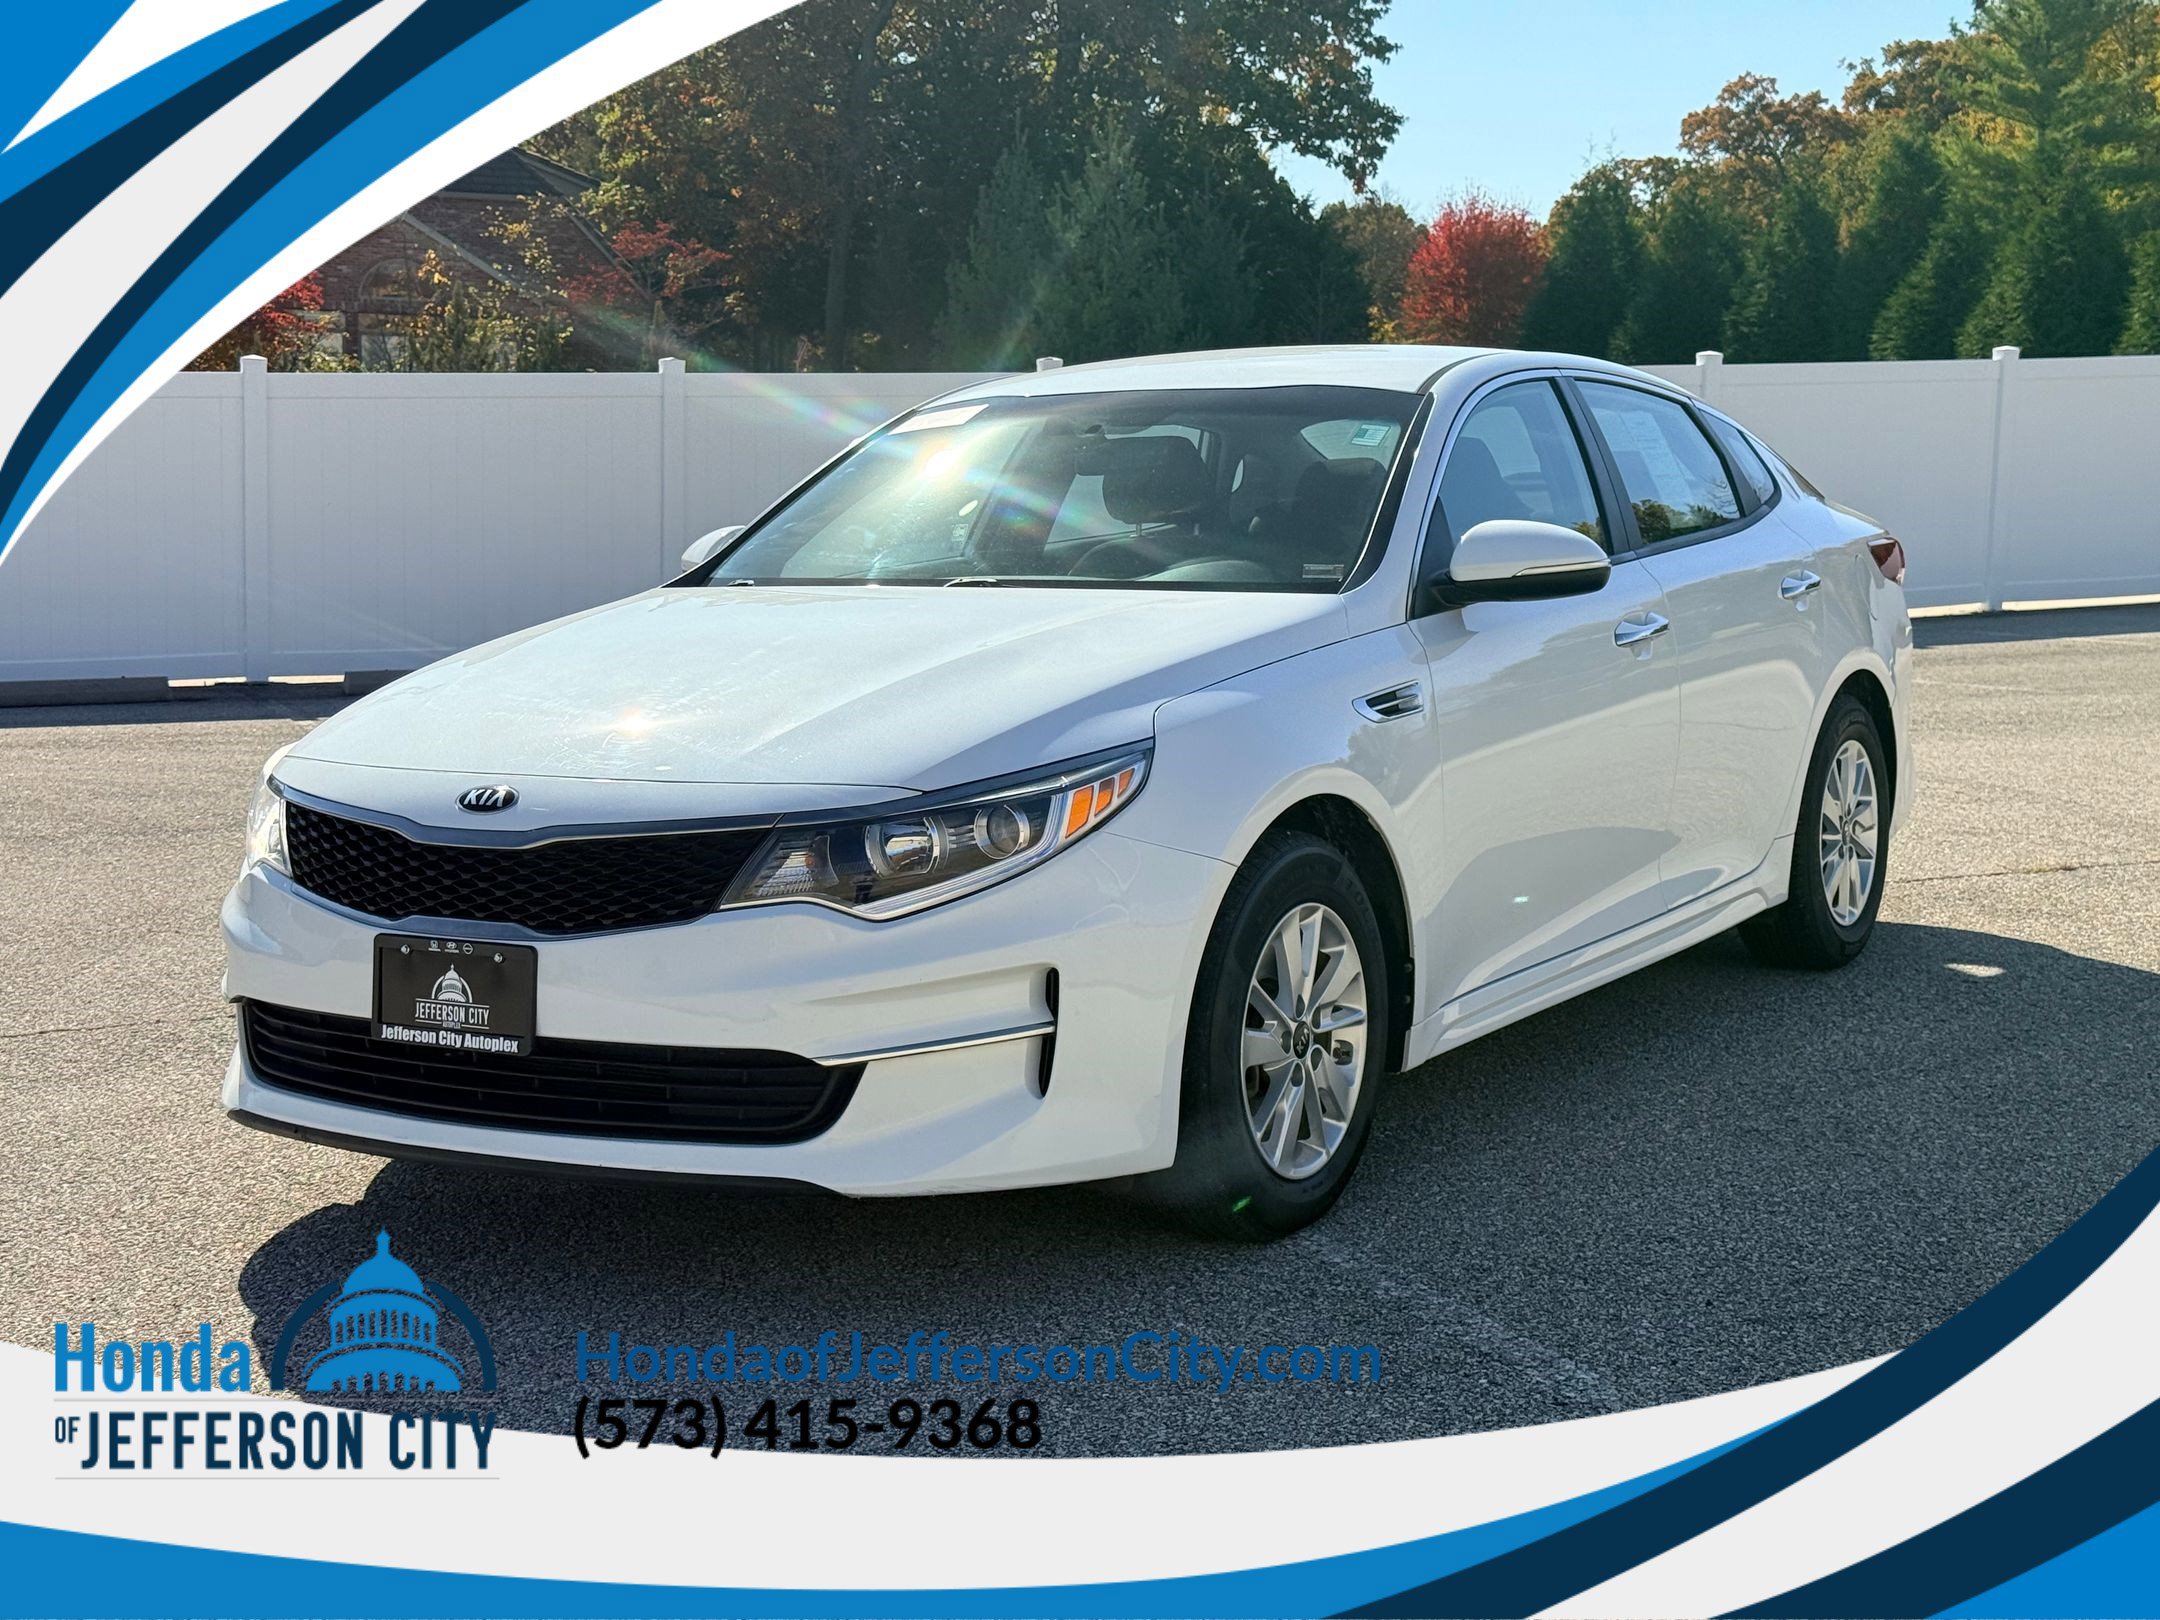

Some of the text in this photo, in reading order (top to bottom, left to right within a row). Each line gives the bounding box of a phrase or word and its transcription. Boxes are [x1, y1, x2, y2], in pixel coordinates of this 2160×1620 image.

[463, 788, 507, 807] KIA
[415, 1002, 465, 1023] JEFFERSON
[468, 1008, 490, 1025] CITY
[381, 1024, 436, 1044] Jefferson
[438, 1030, 462, 1048] City
[464, 1034, 519, 1053] Autoplex
